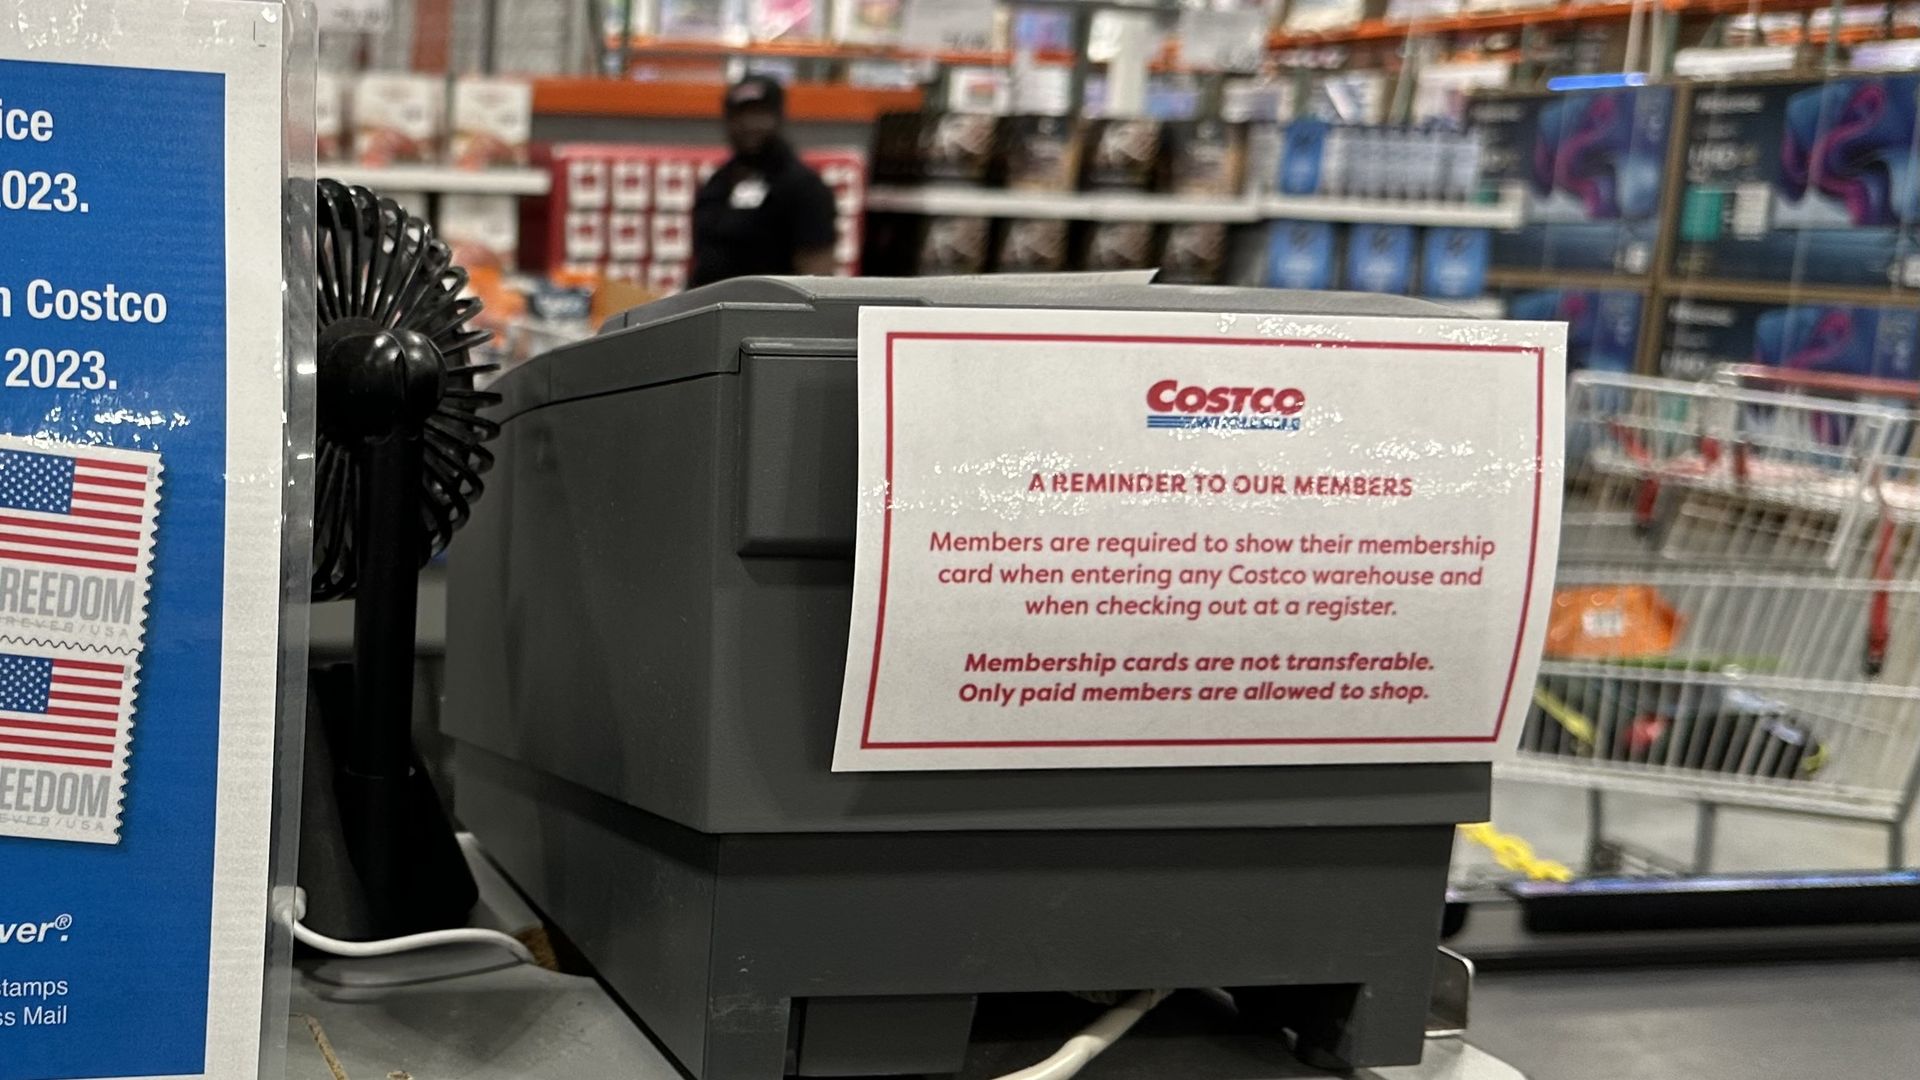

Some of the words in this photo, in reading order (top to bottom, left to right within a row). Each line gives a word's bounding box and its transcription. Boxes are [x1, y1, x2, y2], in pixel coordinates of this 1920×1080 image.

[0, 98, 54, 142] ce
[0, 169, 89, 212] 023.
[27, 278, 168, 324] Costco
[4, 347, 118, 390] 2023.
[1146, 379, 1306, 416] COSTCO
[1028, 473, 1045, 492] A
[1051, 472, 1187, 494] REMINDER
[1194, 474, 1227, 494] TO
[1232, 474, 1285, 496] OUR
[1292, 475, 1413, 497] MEMBERS
[929, 531, 1044, 553] Members
[1049, 536, 1090, 553] are
[1096, 532, 1198, 558] required
[1203, 535, 1229, 553] to
[1235, 533, 1293, 553] show
[1299, 534, 1353, 554] their
[1358, 535, 1496, 560] membership
[937, 563, 994, 584] card
[999, 564, 1065, 584] when
[1070, 564, 1173, 590] entering
[1178, 568, 1223, 590] any
[1228, 564, 1307, 585] Costco
[1312, 566, 1435, 586] warehouse
[1440, 567, 1484, 586] and
[0, 566, 136, 625] REEDOM
[1024, 595, 1091, 615] when
[1096, 595, 1203, 621] checking
[1208, 598, 1247, 616] out
[1253, 598, 1279, 616] at
[1285, 601, 1301, 615] a
[1306, 596, 1398, 621] register.
[0, 615, 130, 639] REVER/USA
[965, 653, 1117, 677] Membership
[1122, 653, 1190, 672] cards
[1195, 656, 1235, 672] are
[1240, 654, 1281, 671] not
[1286, 652, 1435, 672] transferable.
[959, 683, 1016, 707] Only
[1019, 683, 1077, 707] paid
[1081, 683, 1193, 702] members
[1199, 686, 1238, 700] are
[1243, 681, 1336, 701] allowed
[1340, 682, 1365, 700] to
[1370, 681, 1429, 704] shop.
[0, 979, 69, 1001] tamps
[0, 1011, 16, 1027] s
[23, 1004, 68, 1026] Mail
